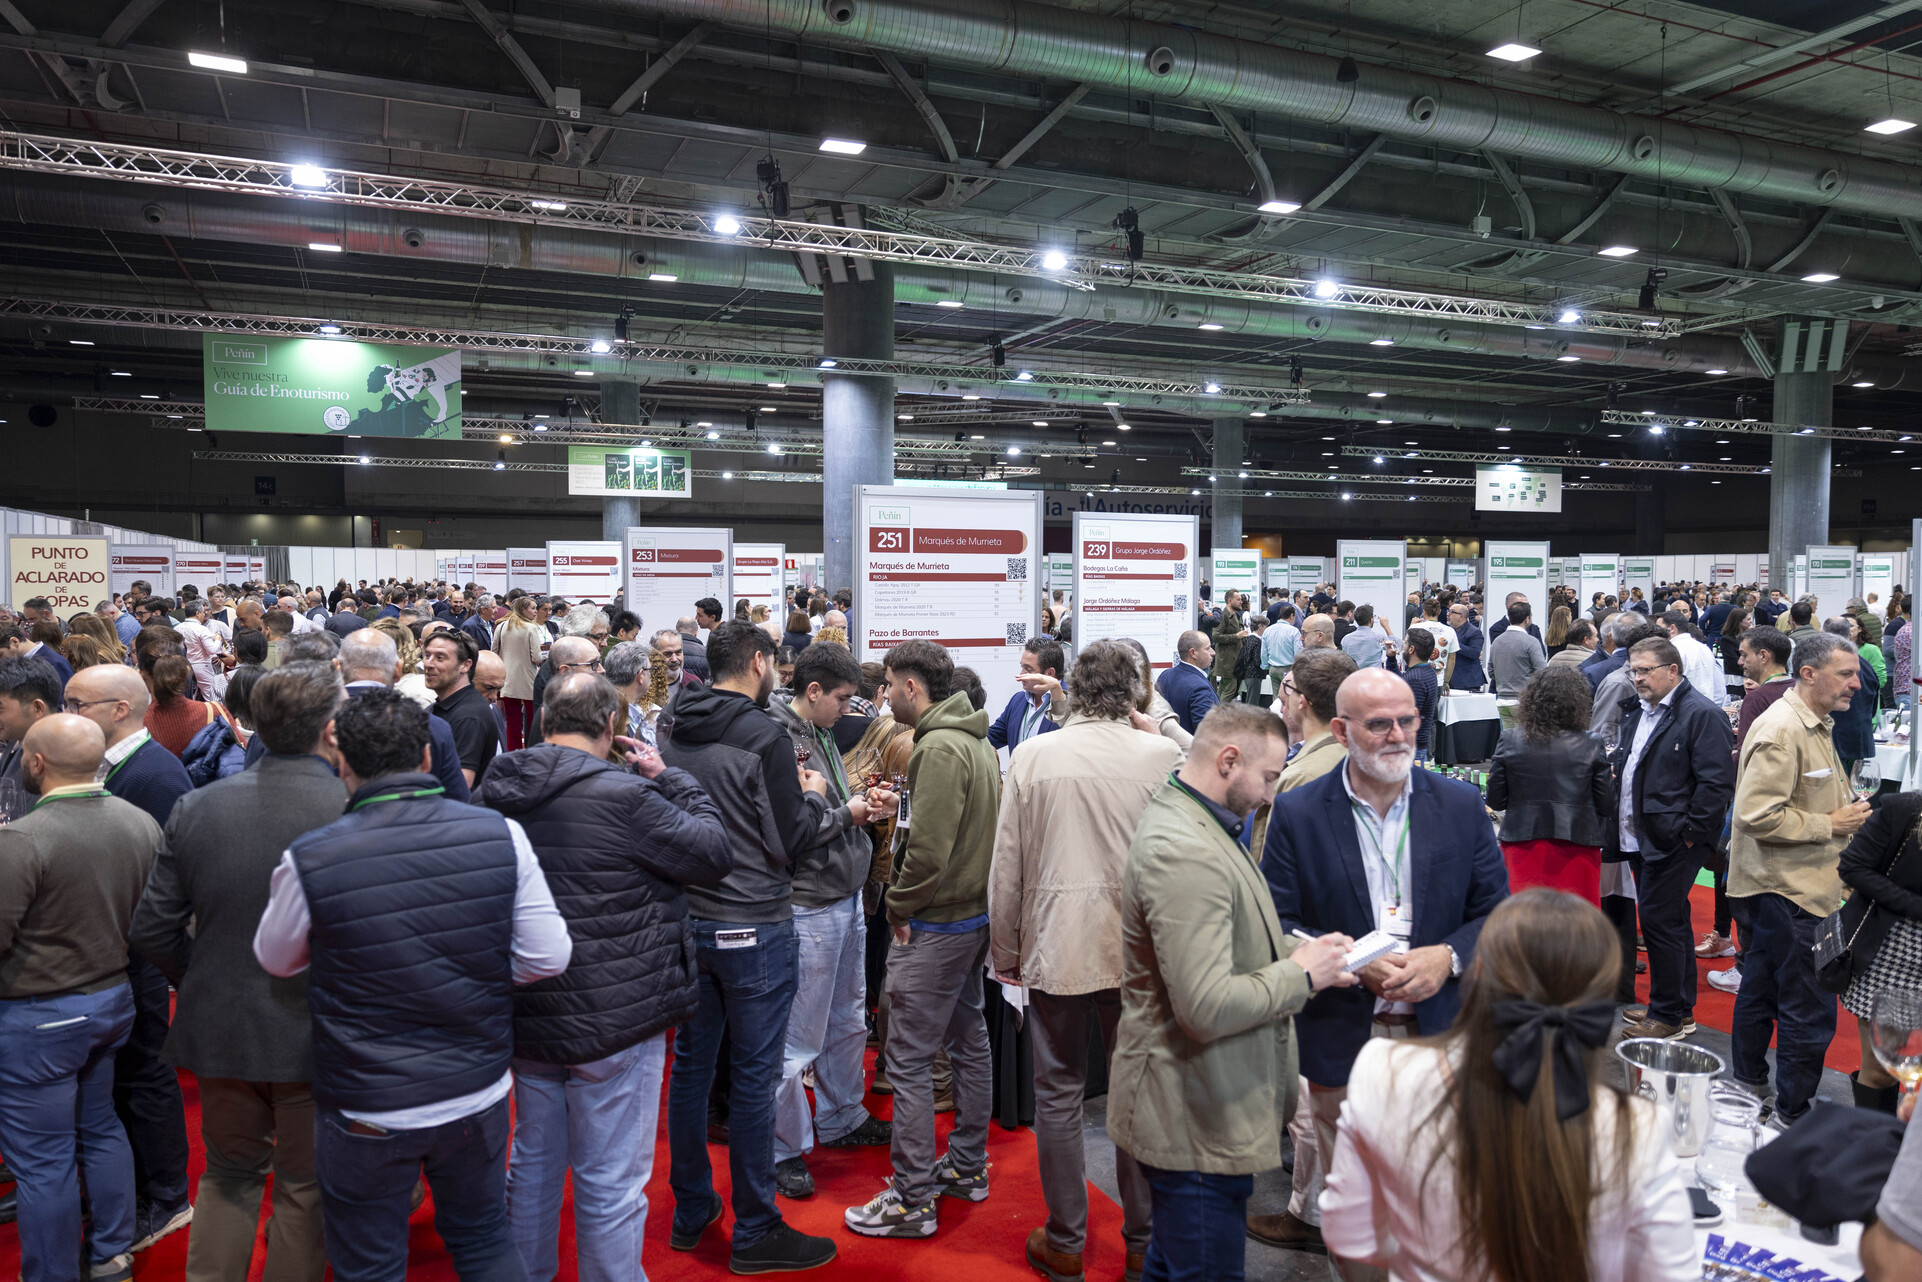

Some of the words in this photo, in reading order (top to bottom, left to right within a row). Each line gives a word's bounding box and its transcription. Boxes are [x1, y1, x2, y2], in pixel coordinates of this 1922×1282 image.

[225, 346, 255, 359] Peñín
[214, 367, 240, 380] Vive
[242, 370, 288, 383] nuestra
[214, 382, 248, 396] Guía
[250, 384, 268, 397] de
[270, 385, 350, 401] Enoturismo
[878, 510, 901, 520] Peñín
[877, 532, 902, 548] 251
[918, 536, 954, 547] Marqués
[956, 537, 966, 545] de
[969, 536, 1002, 546] Murrieta
[32, 547, 88, 559] PUNTO
[636, 551, 652, 560] 253
[1088, 544, 1107, 556] 239
[869, 562, 904, 571] Marqués
[14, 571, 105, 584] ACLARADO
